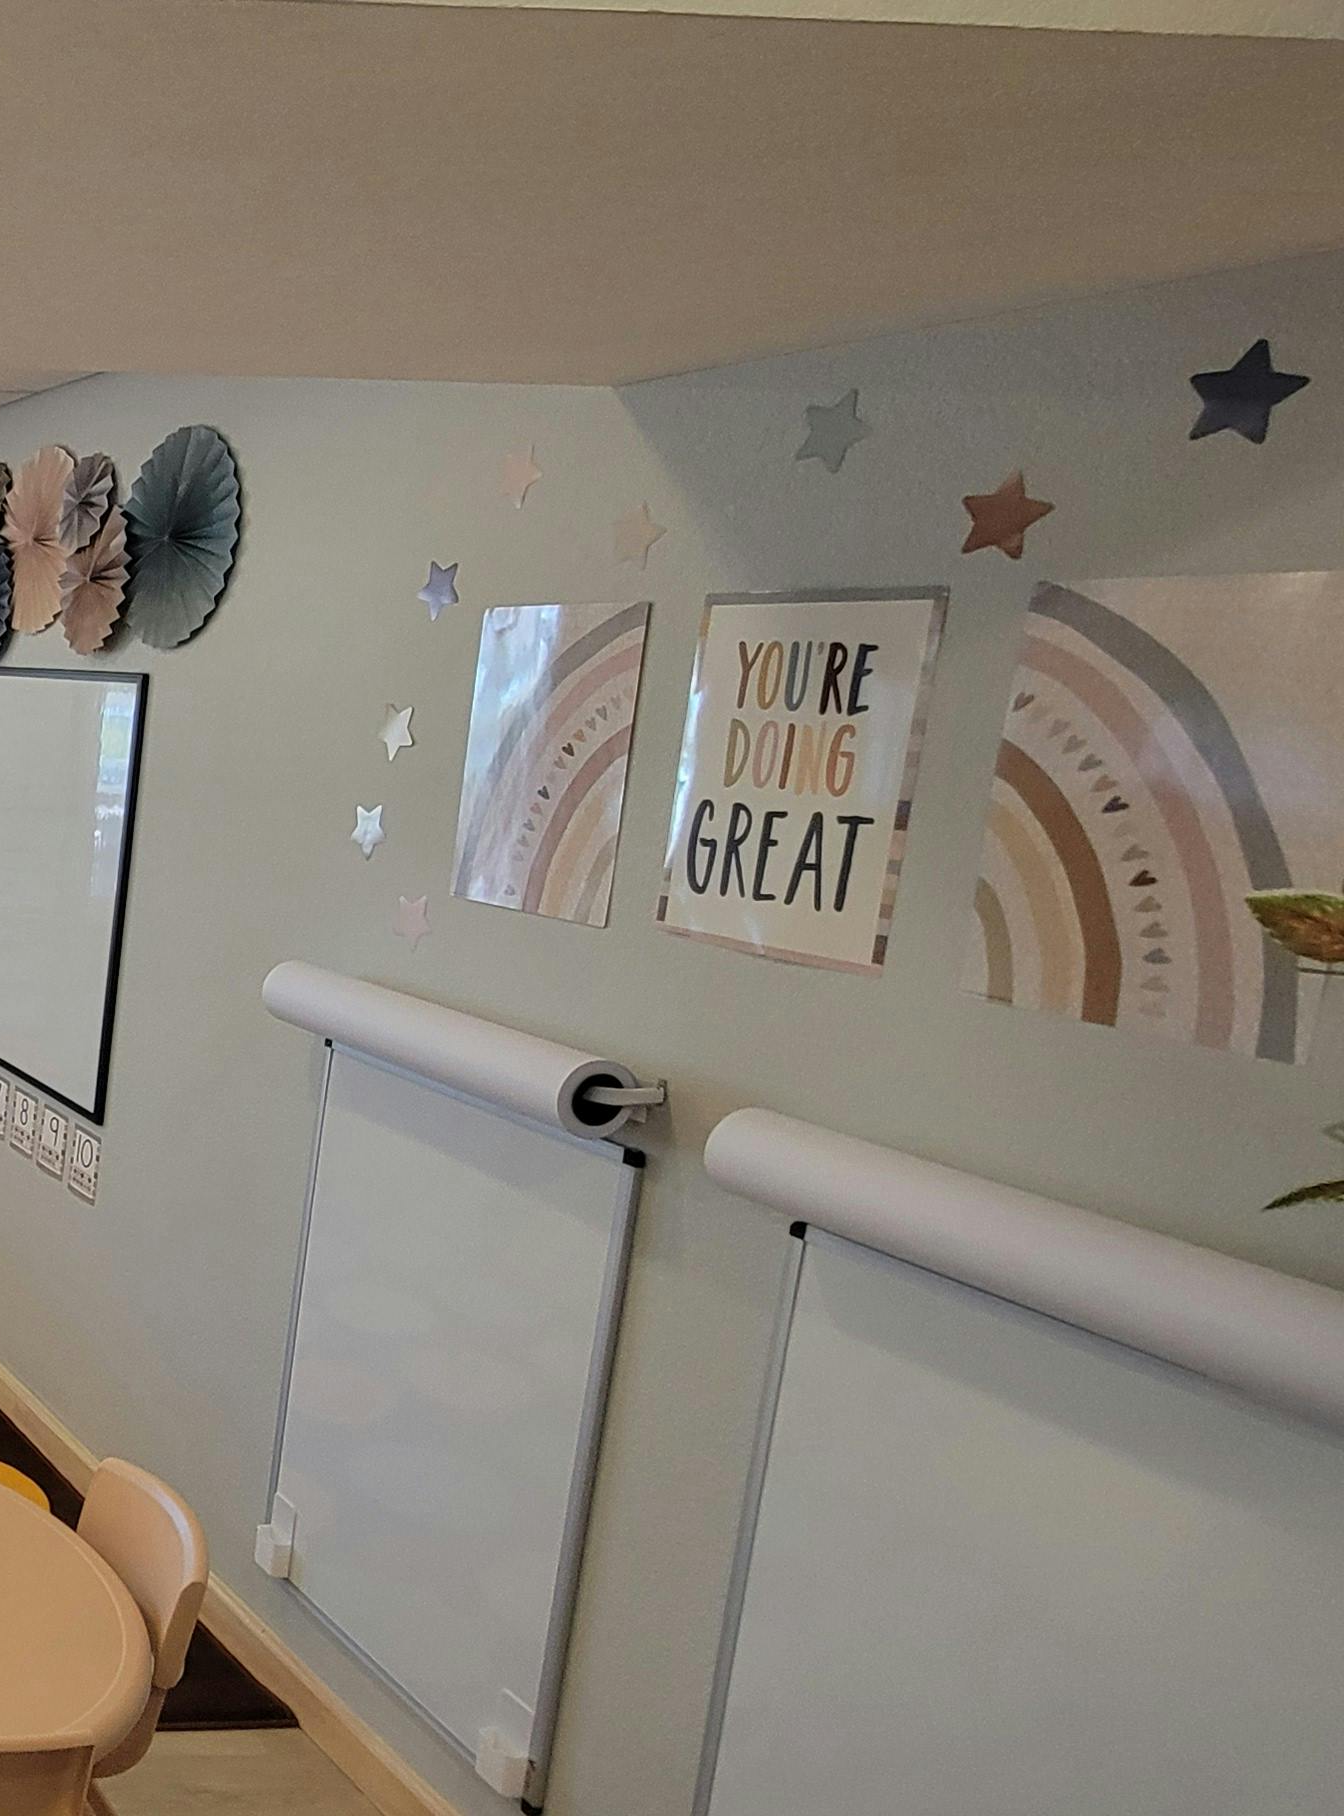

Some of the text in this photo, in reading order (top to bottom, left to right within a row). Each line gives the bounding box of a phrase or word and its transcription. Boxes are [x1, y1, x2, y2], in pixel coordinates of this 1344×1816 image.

[736, 640, 880, 716] YOU'RE
[723, 718, 857, 798] DOING
[686, 799, 876, 912] GREAT
[20, 1098, 29, 1126] 8
[49, 1116, 60, 1147] 9
[75, 1133, 94, 1168] 10
